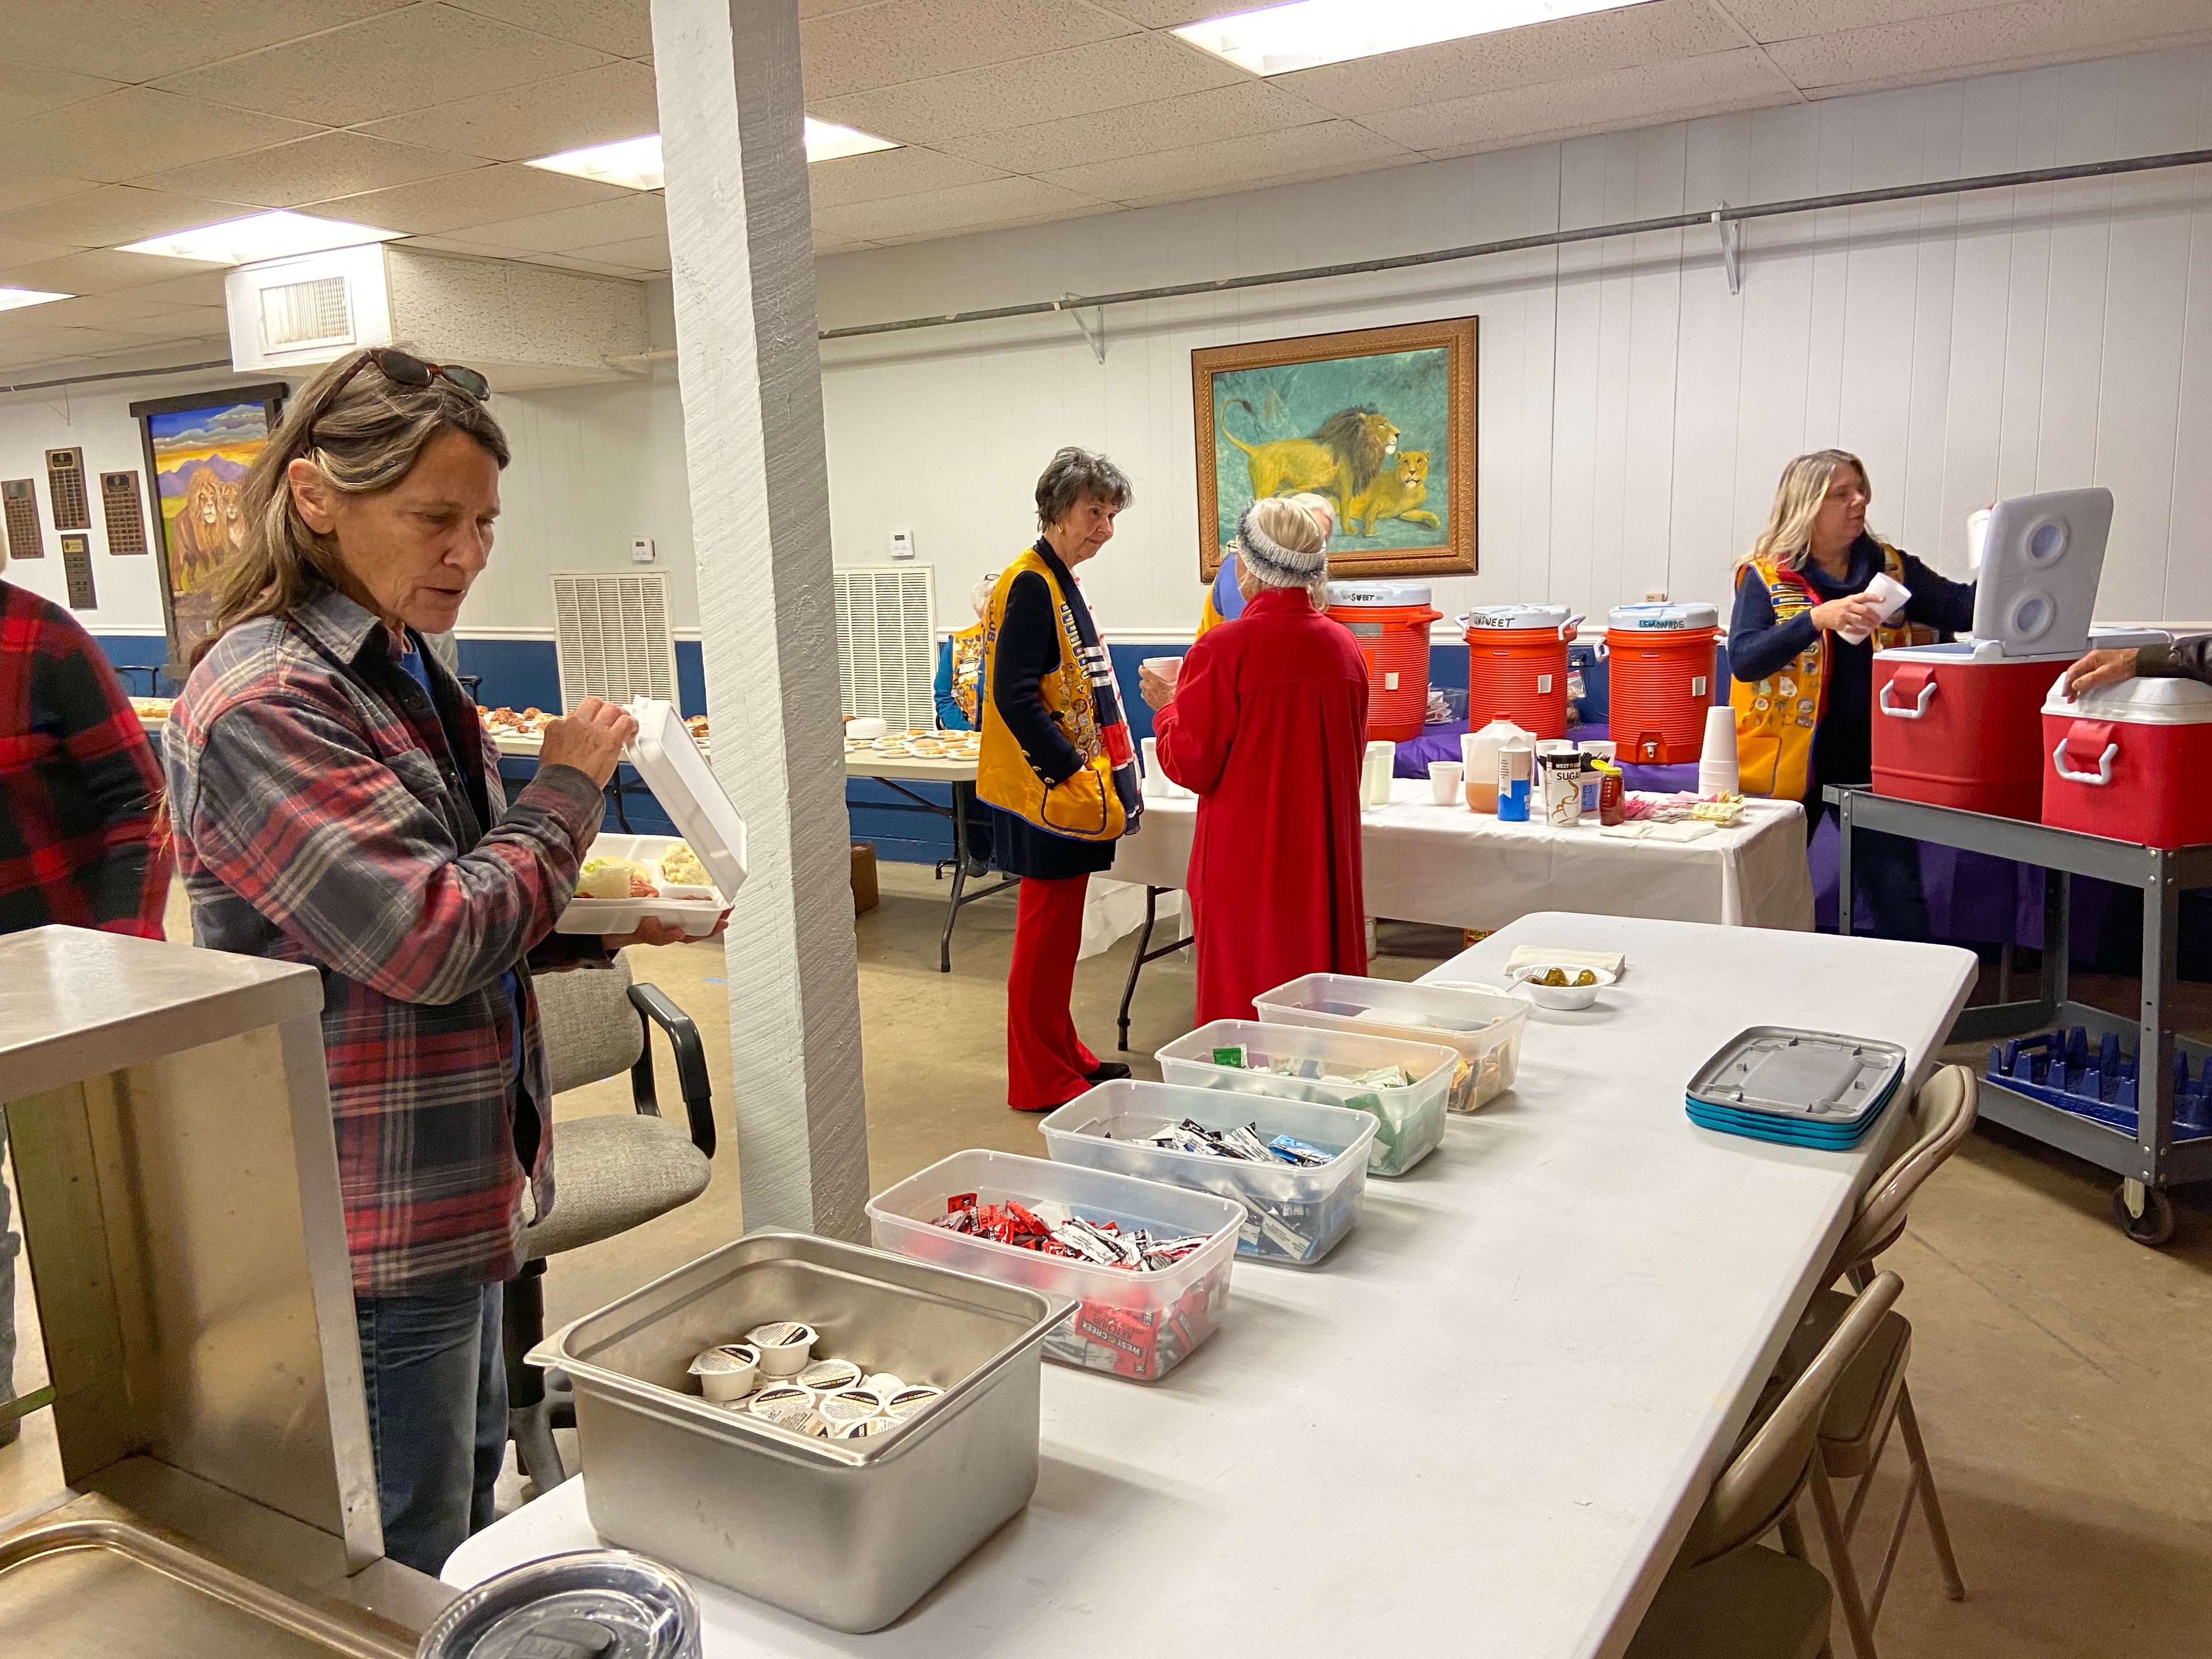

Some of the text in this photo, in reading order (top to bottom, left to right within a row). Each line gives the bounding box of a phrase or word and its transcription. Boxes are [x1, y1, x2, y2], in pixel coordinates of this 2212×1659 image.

[1351, 593, 1375, 601] SWEET
[1474, 615, 1516, 628] UNSWEET
[1639, 620, 1685, 629] LEMONADE
[1556, 772, 1581, 781] SUGA
[1094, 1316, 1133, 1342] KETCHUP
[1082, 1320, 1140, 1356] WEST CREEK
[859, 1396, 878, 1404] CREEK
